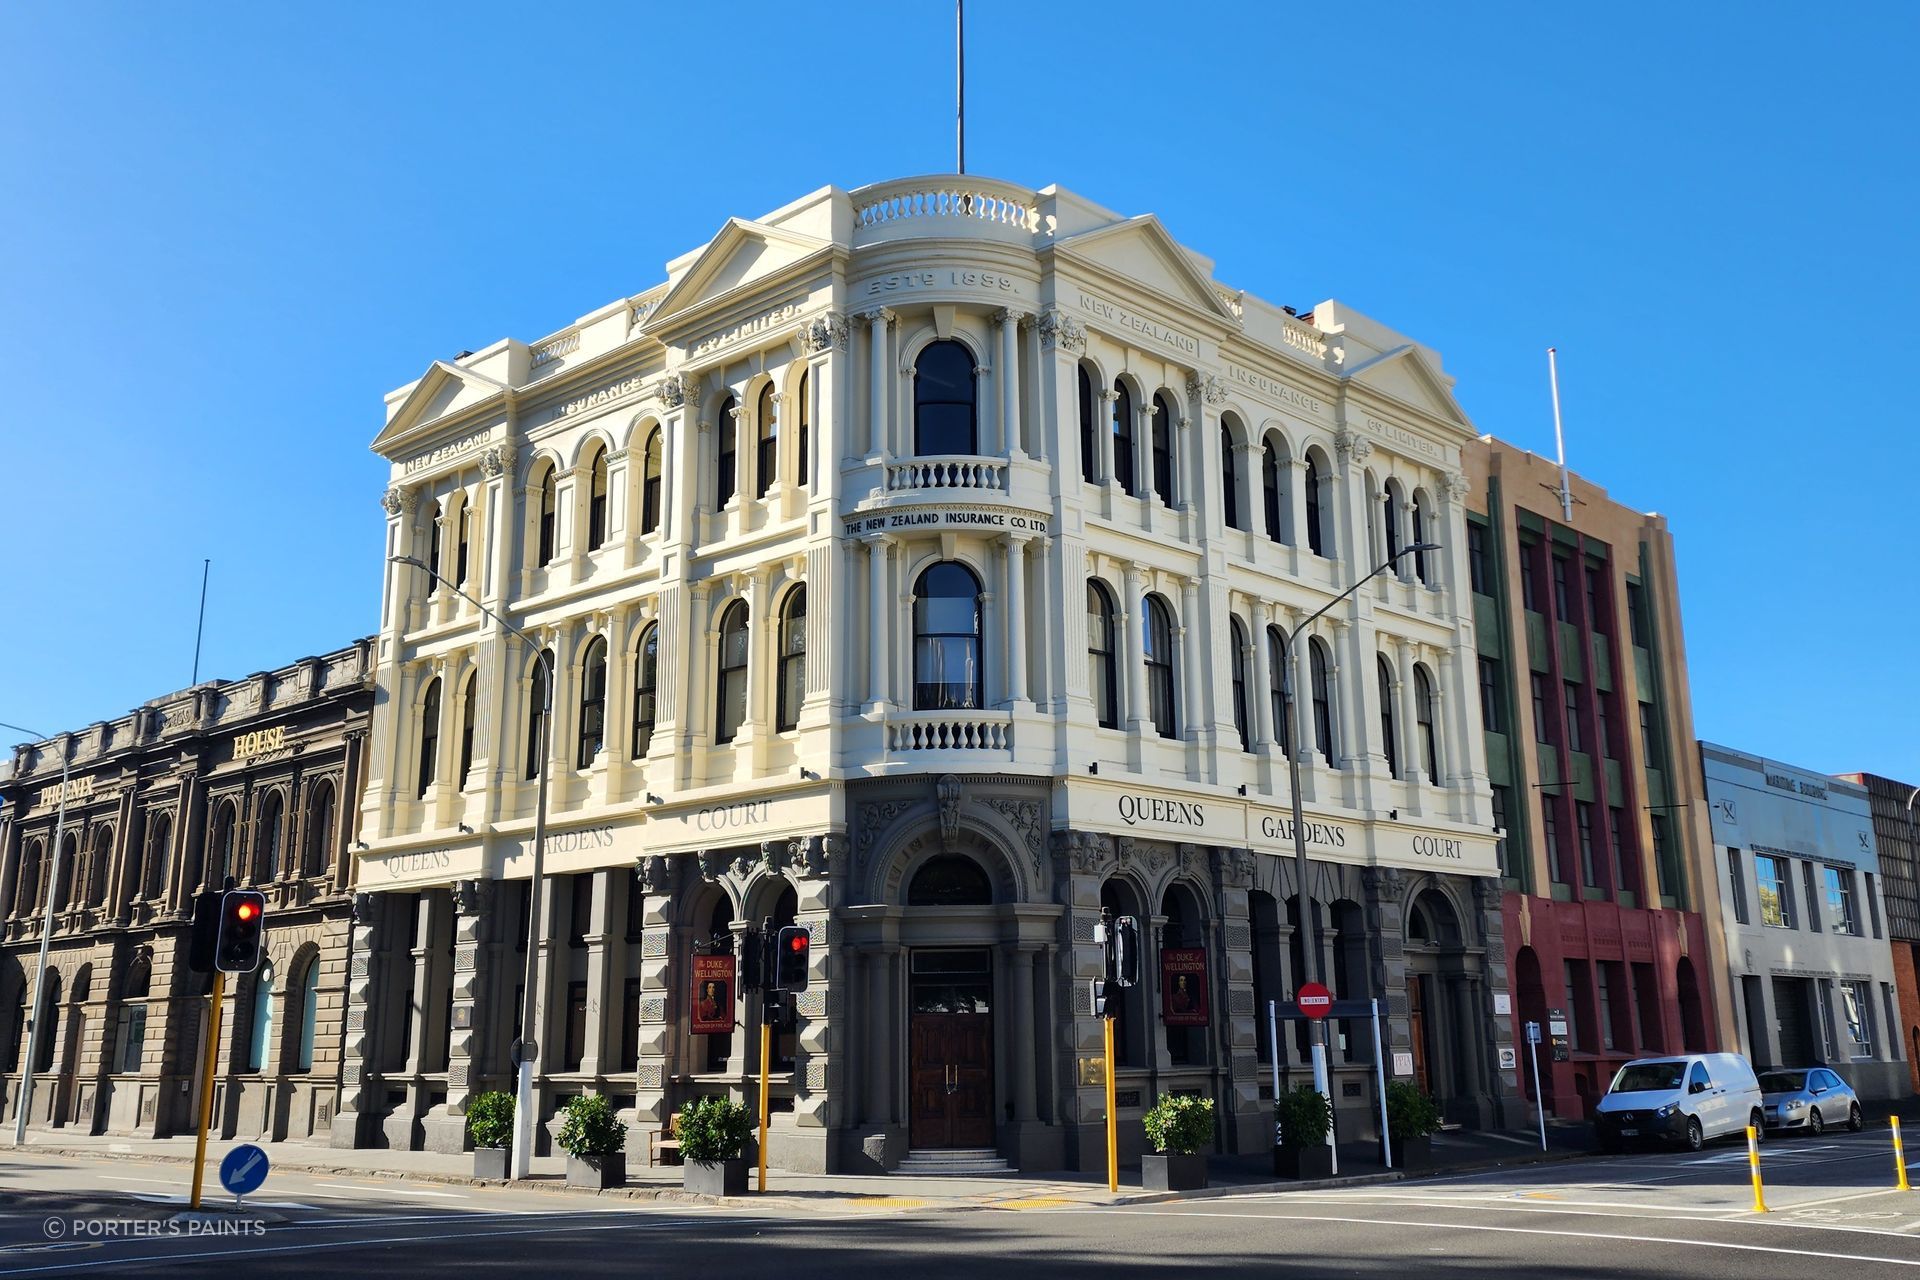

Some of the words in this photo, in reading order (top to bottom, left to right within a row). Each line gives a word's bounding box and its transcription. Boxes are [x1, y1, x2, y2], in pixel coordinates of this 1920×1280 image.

[1079, 294, 1114, 321] NEW
[1119, 311, 1196, 353] ZEALAND
[552, 375, 643, 421] INSURANCE
[1228, 364, 1321, 414] INSURANCE
[405, 453, 431, 476] NEW
[432, 430, 491, 461] ZEALAND
[846, 522, 861, 535] THE
[866, 517, 885, 531] NEW
[891, 512, 939, 527] ZEALAND
[945, 512, 1005, 526] INSURANCE
[1010, 516, 1027, 529] CO.
[1030, 519, 1047, 533] LTD.
[40, 774, 96, 807] PHOENIX
[232, 725, 286, 761] HOUSE
[388, 848, 451, 878] QUEENS
[697, 799, 773, 832] COURT
[1118, 794, 1204, 827] QUEENS
[1262, 816, 1345, 847] GARDENS
[1412, 834, 1463, 859] COURT
[694, 969, 733, 978] WELLINGTON
[706, 960, 723, 968] DUKE
[1165, 962, 1205, 971] WELLINGTON
[1176, 952, 1194, 961] DUKE
